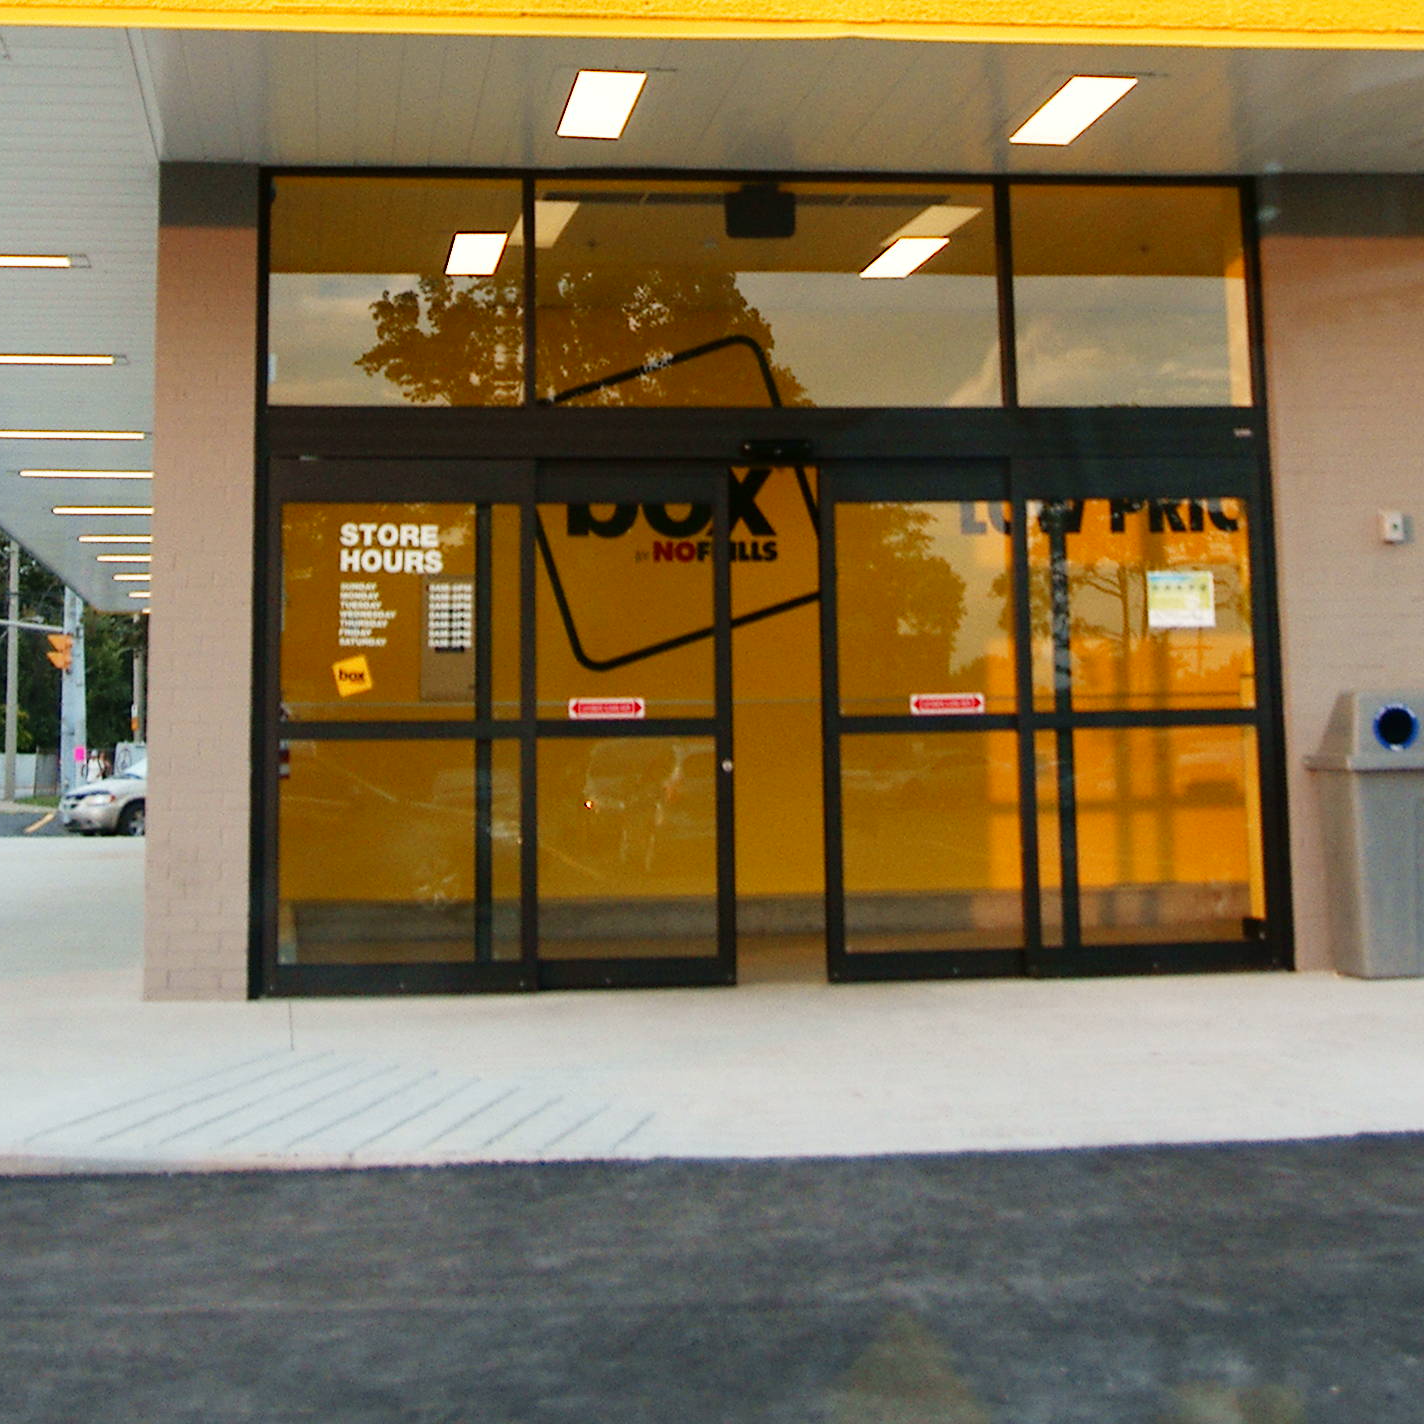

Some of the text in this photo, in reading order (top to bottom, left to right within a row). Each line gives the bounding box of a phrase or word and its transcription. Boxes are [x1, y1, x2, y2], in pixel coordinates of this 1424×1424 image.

[339, 522, 440, 548] STORE
[339, 548, 444, 574] HOURS
[339, 669, 365, 681] box
